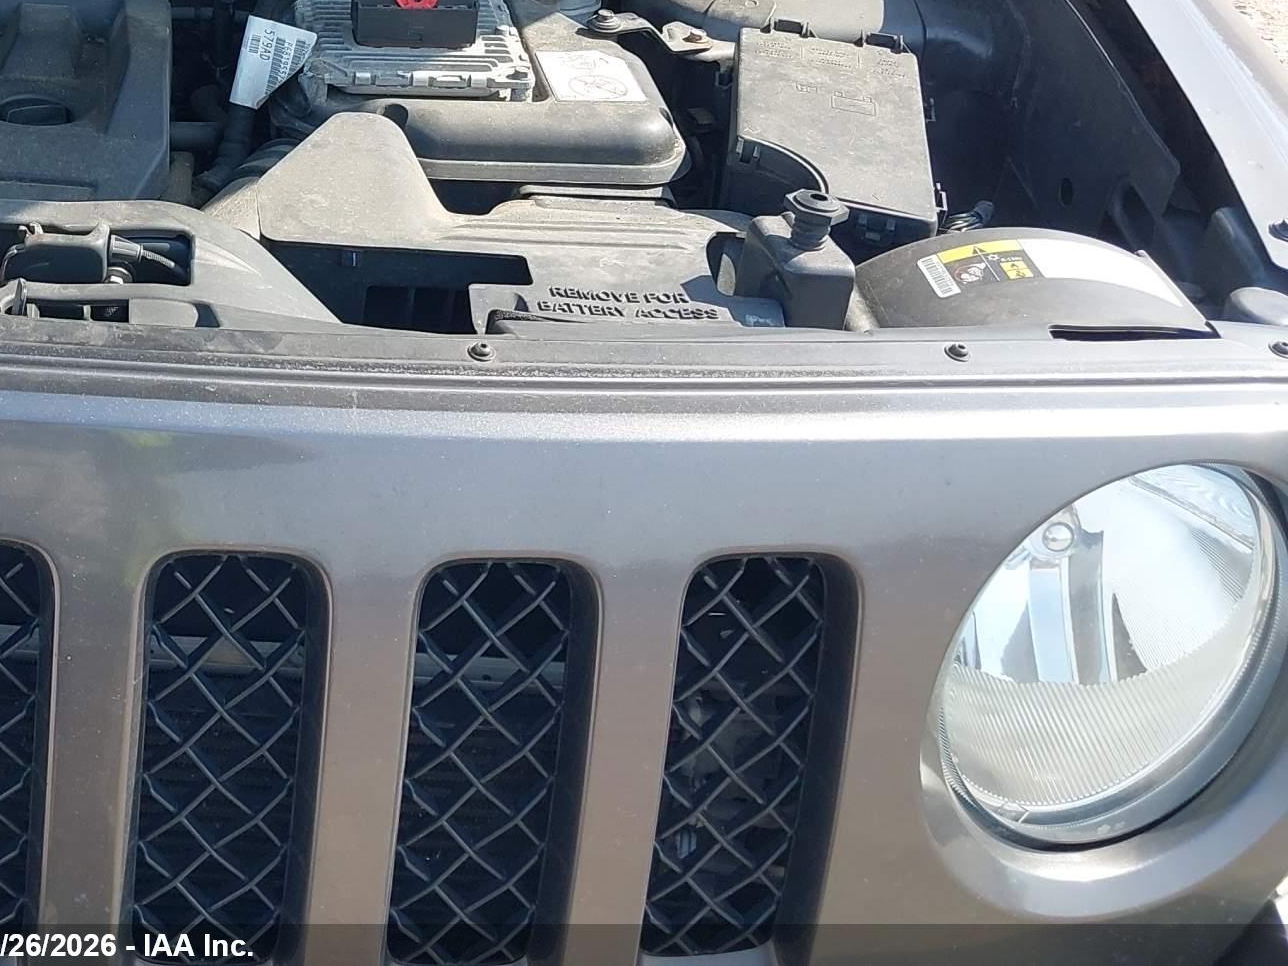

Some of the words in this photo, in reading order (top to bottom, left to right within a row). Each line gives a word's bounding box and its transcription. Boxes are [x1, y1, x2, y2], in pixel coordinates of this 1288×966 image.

[259, 28, 275, 61] 579AD
[548, 285, 641, 304] REMOVE
[642, 290, 691, 305] FOR
[536, 300, 626, 318] BATTERY
[634, 307, 720, 320] ACCESS
